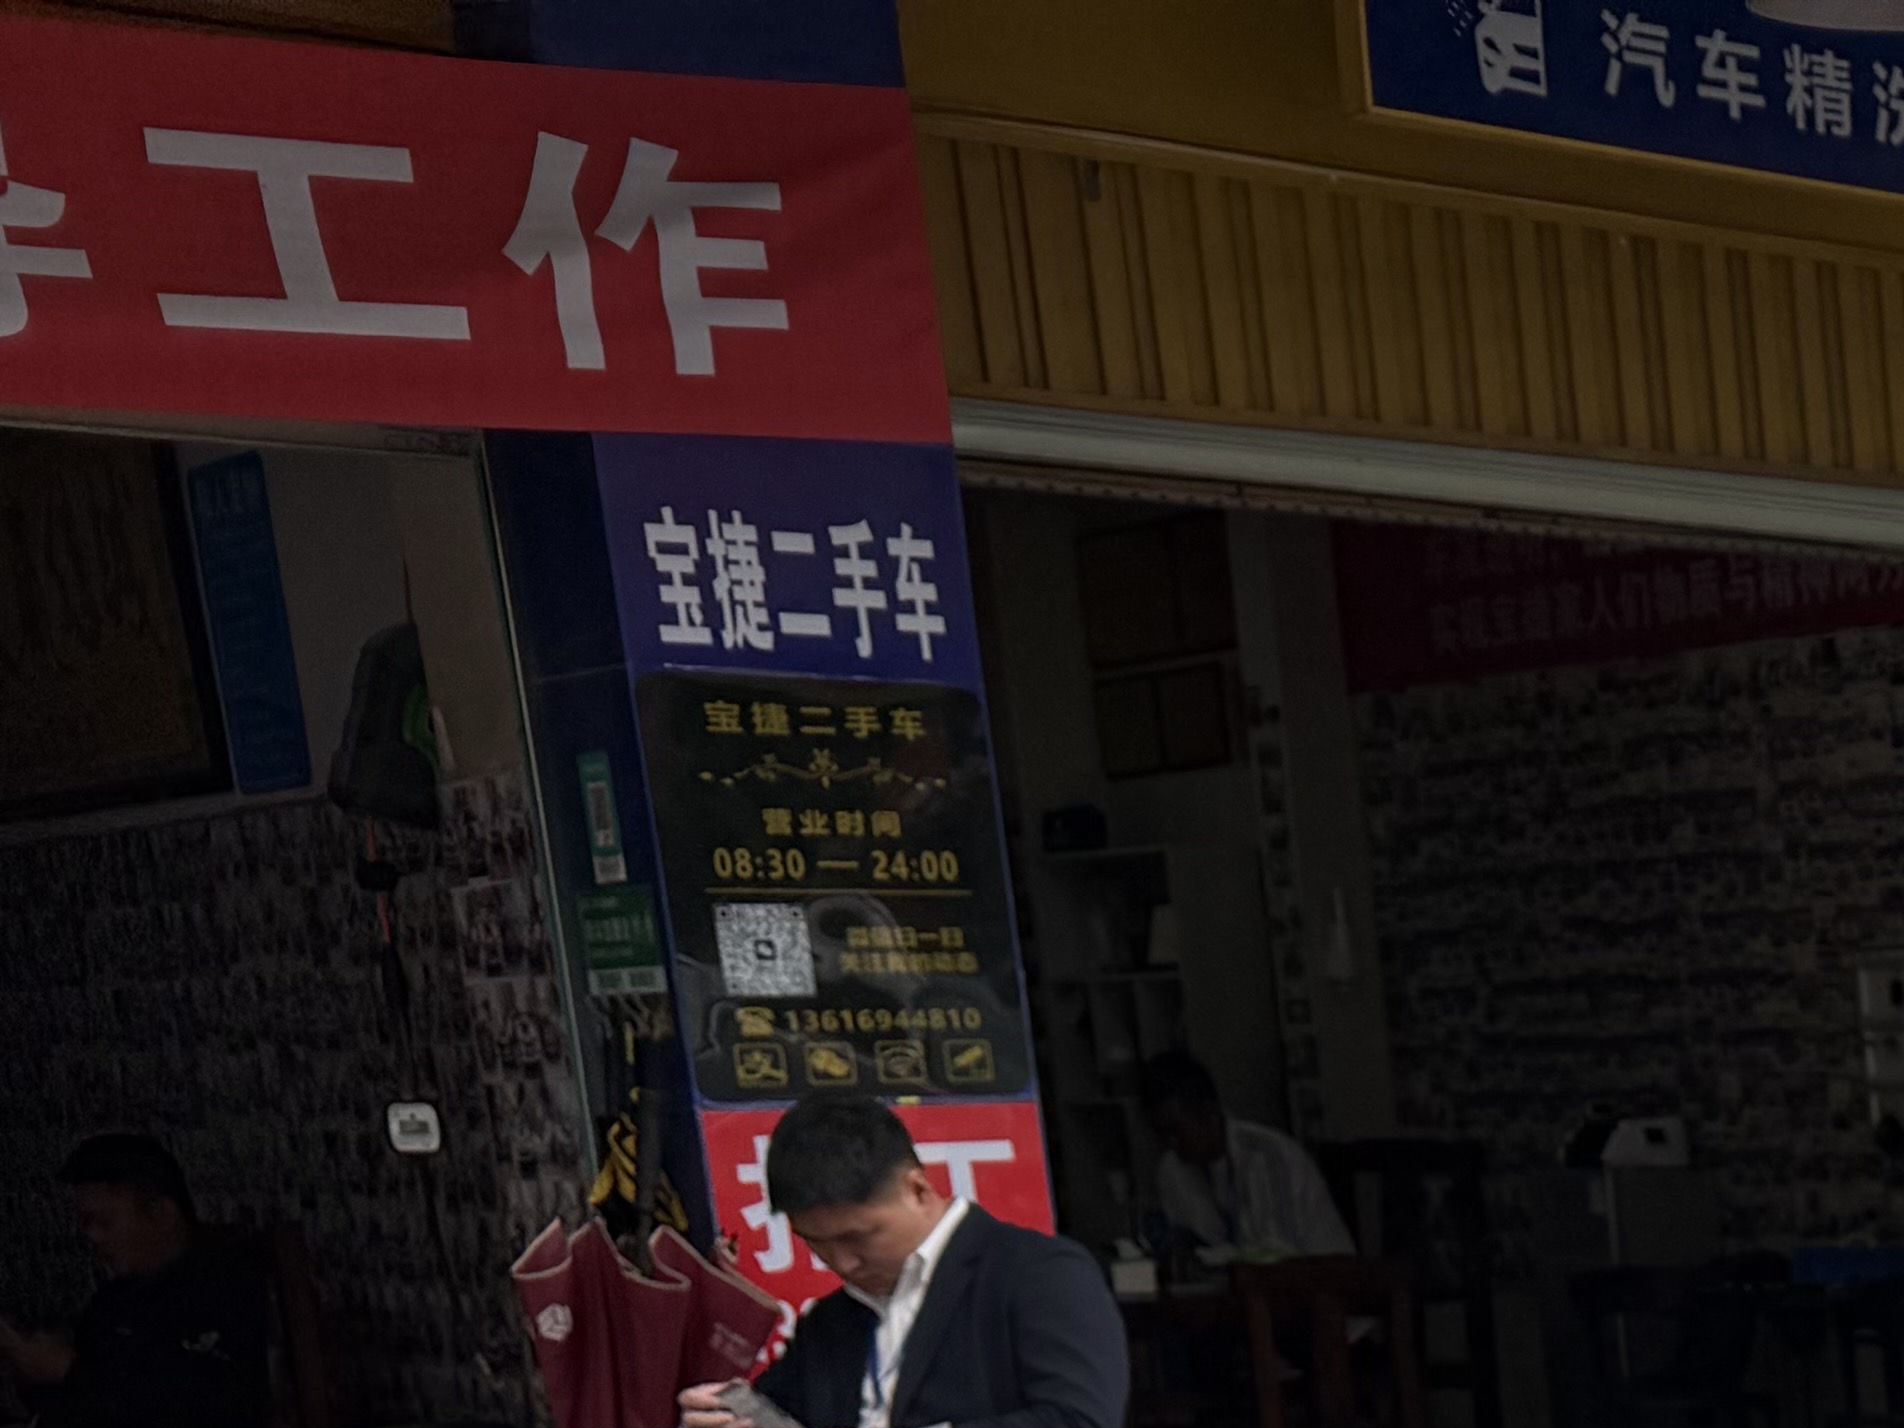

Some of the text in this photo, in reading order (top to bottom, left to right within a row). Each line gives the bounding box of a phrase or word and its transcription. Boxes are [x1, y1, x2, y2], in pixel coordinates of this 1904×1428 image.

[643, 505, 948, 663] 宝捷二手车
[703, 701, 926, 742] 宝捷二手车
[762, 807, 903, 838] 营业时间
[712, 846, 806, 879] 08:30
[871, 850, 960, 882] 24:00
[787, 1006, 982, 1033] 13616944810
